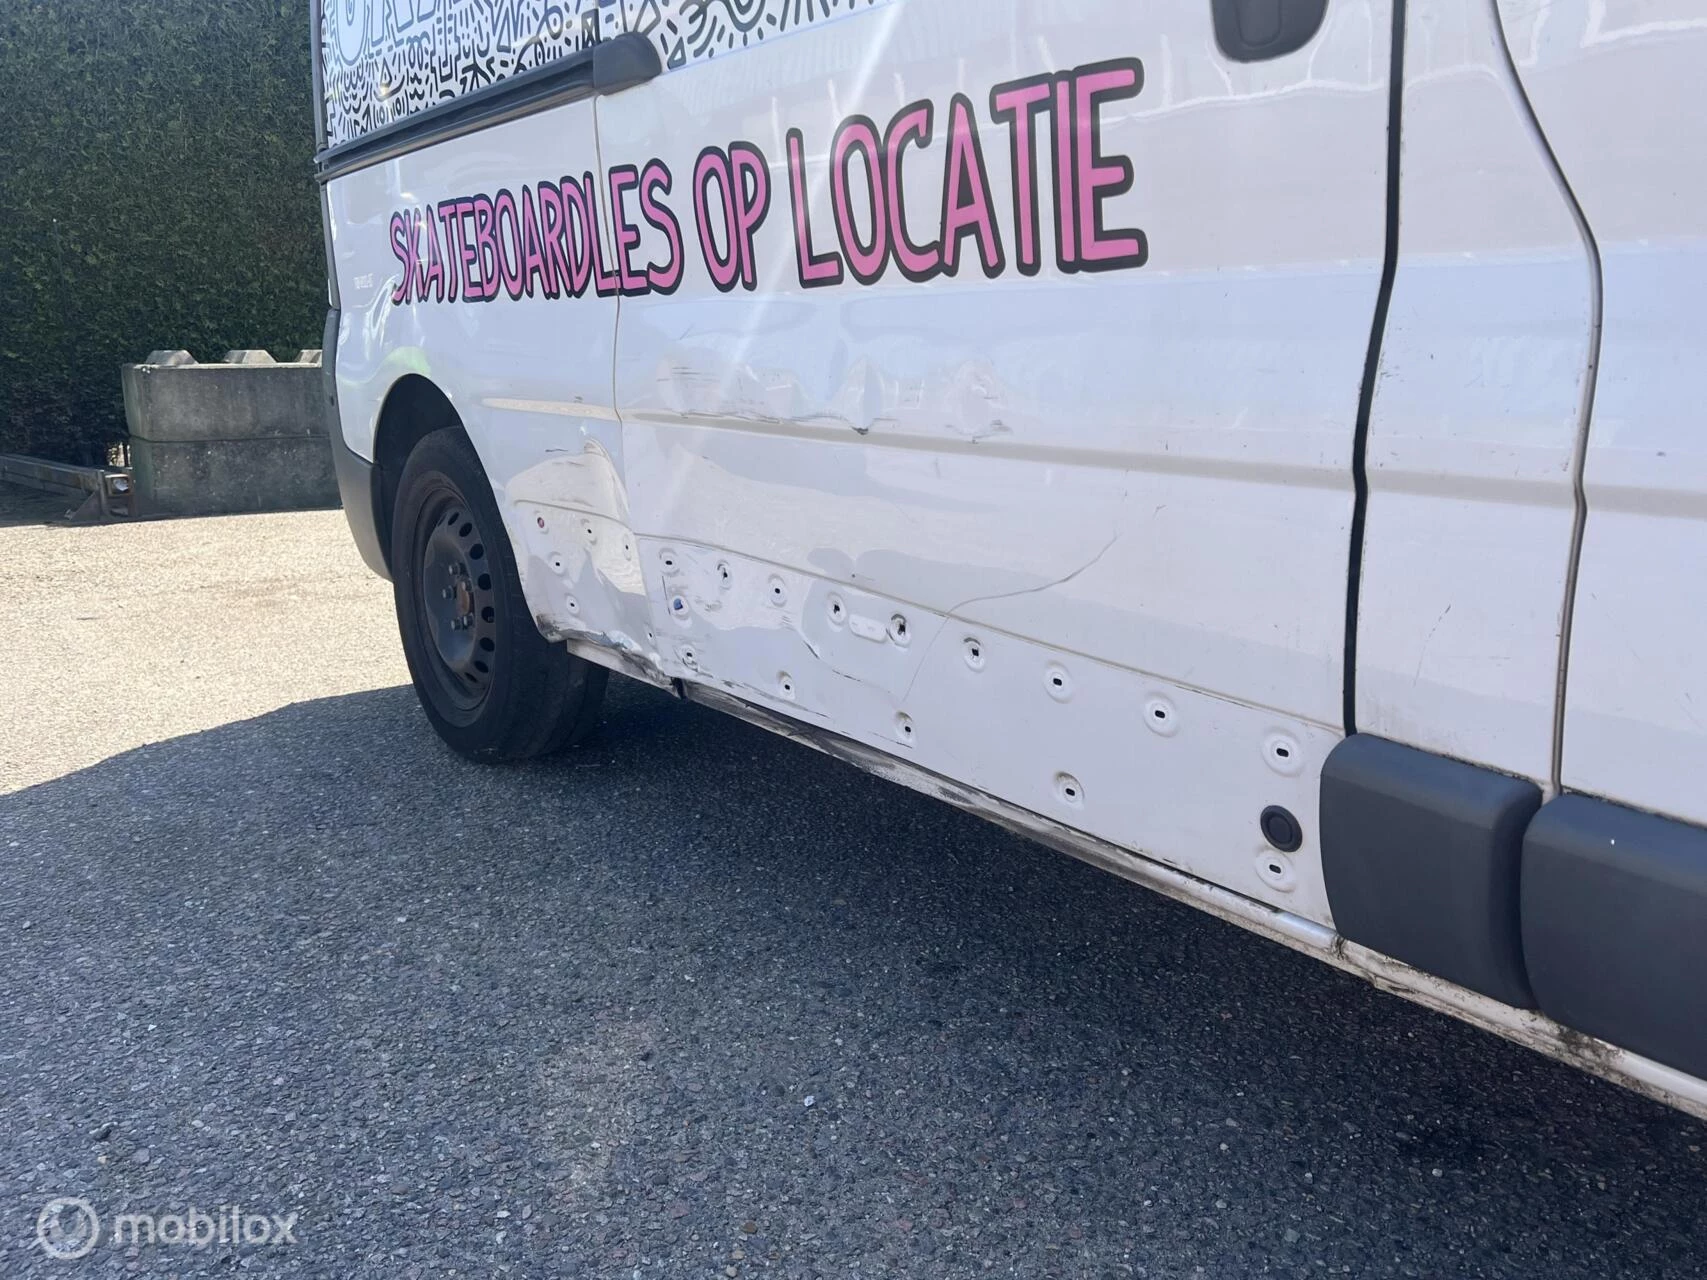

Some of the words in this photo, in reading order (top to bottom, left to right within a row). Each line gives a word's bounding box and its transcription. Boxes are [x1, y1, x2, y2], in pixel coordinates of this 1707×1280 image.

[390, 158, 684, 304] SKATEBOARDLES
[693, 141, 770, 291] OP
[787, 57, 1148, 288] LOCATIE
